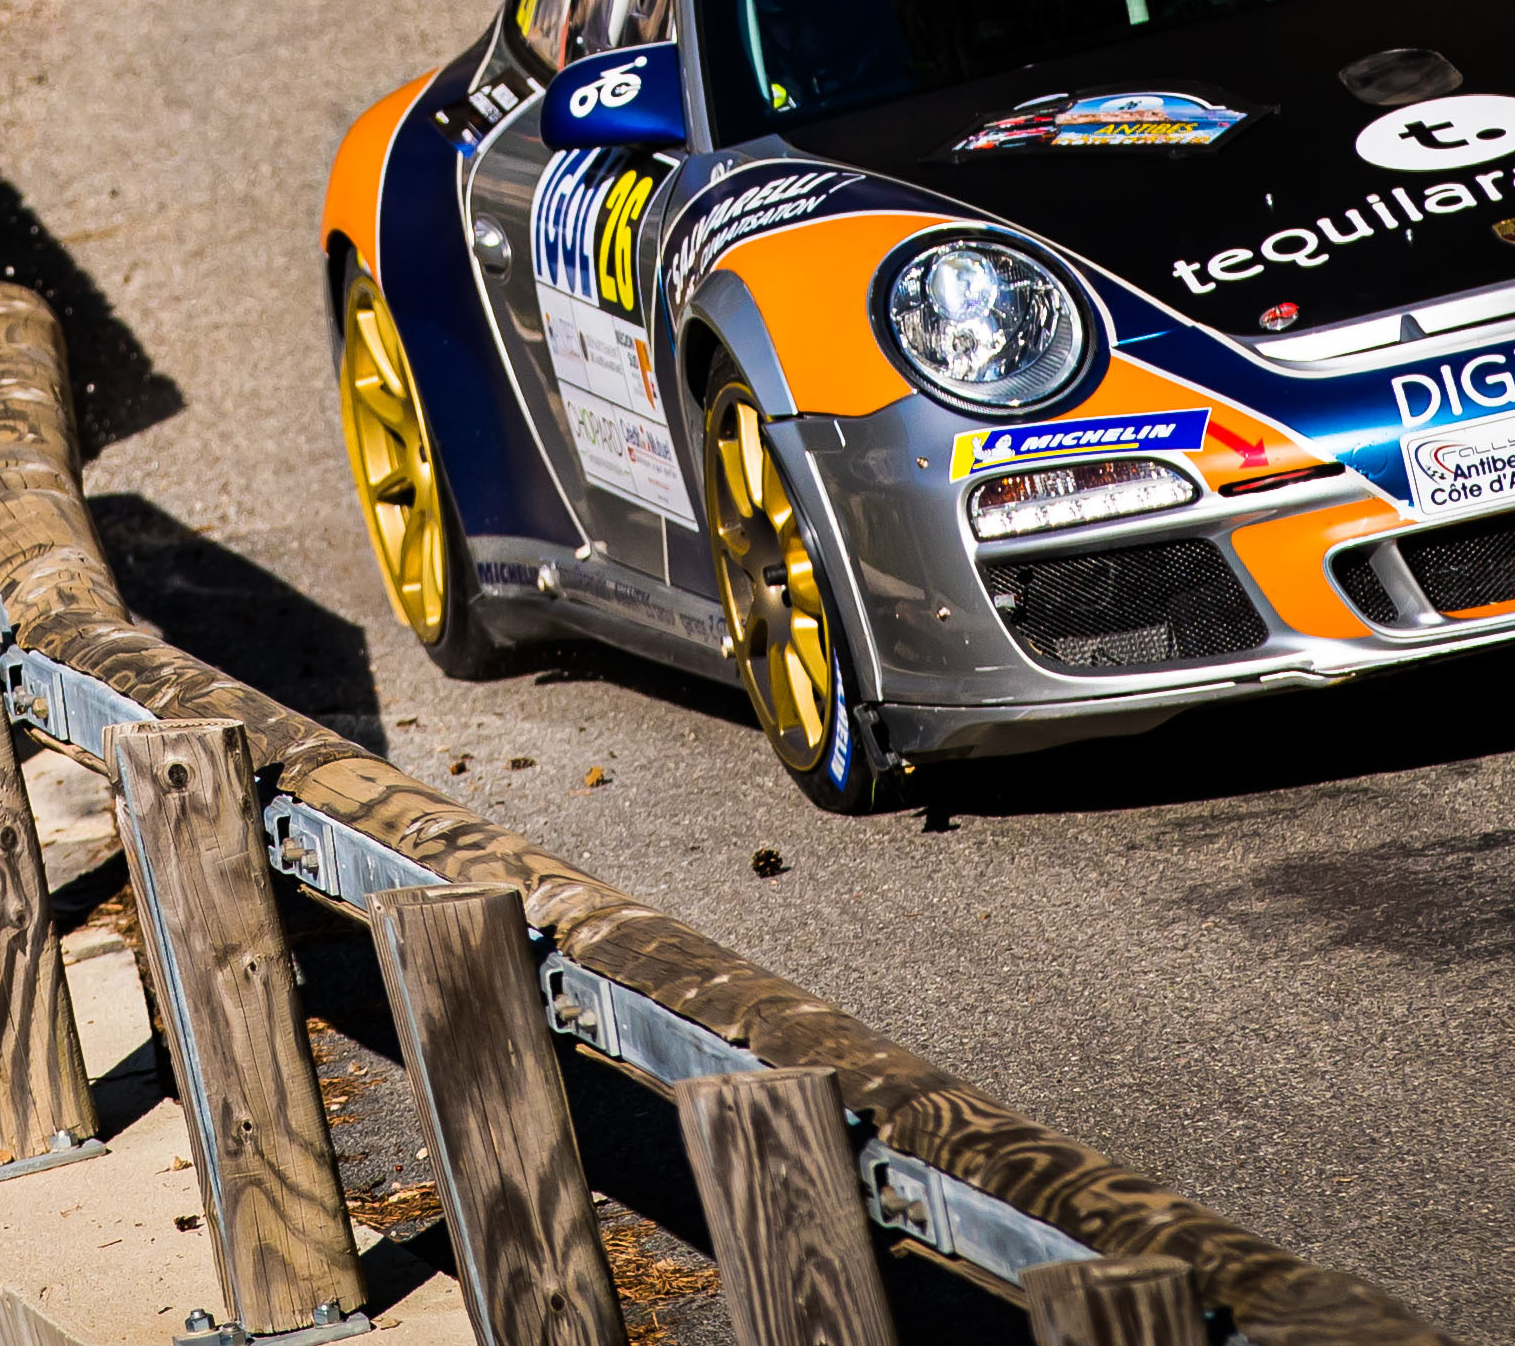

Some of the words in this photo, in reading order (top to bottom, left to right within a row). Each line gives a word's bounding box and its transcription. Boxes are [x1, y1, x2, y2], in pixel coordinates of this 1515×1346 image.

[598, 169, 653, 312] 26
[1019, 422, 1177, 453] MICHELIN
[1430, 479, 1483, 507] Côte
